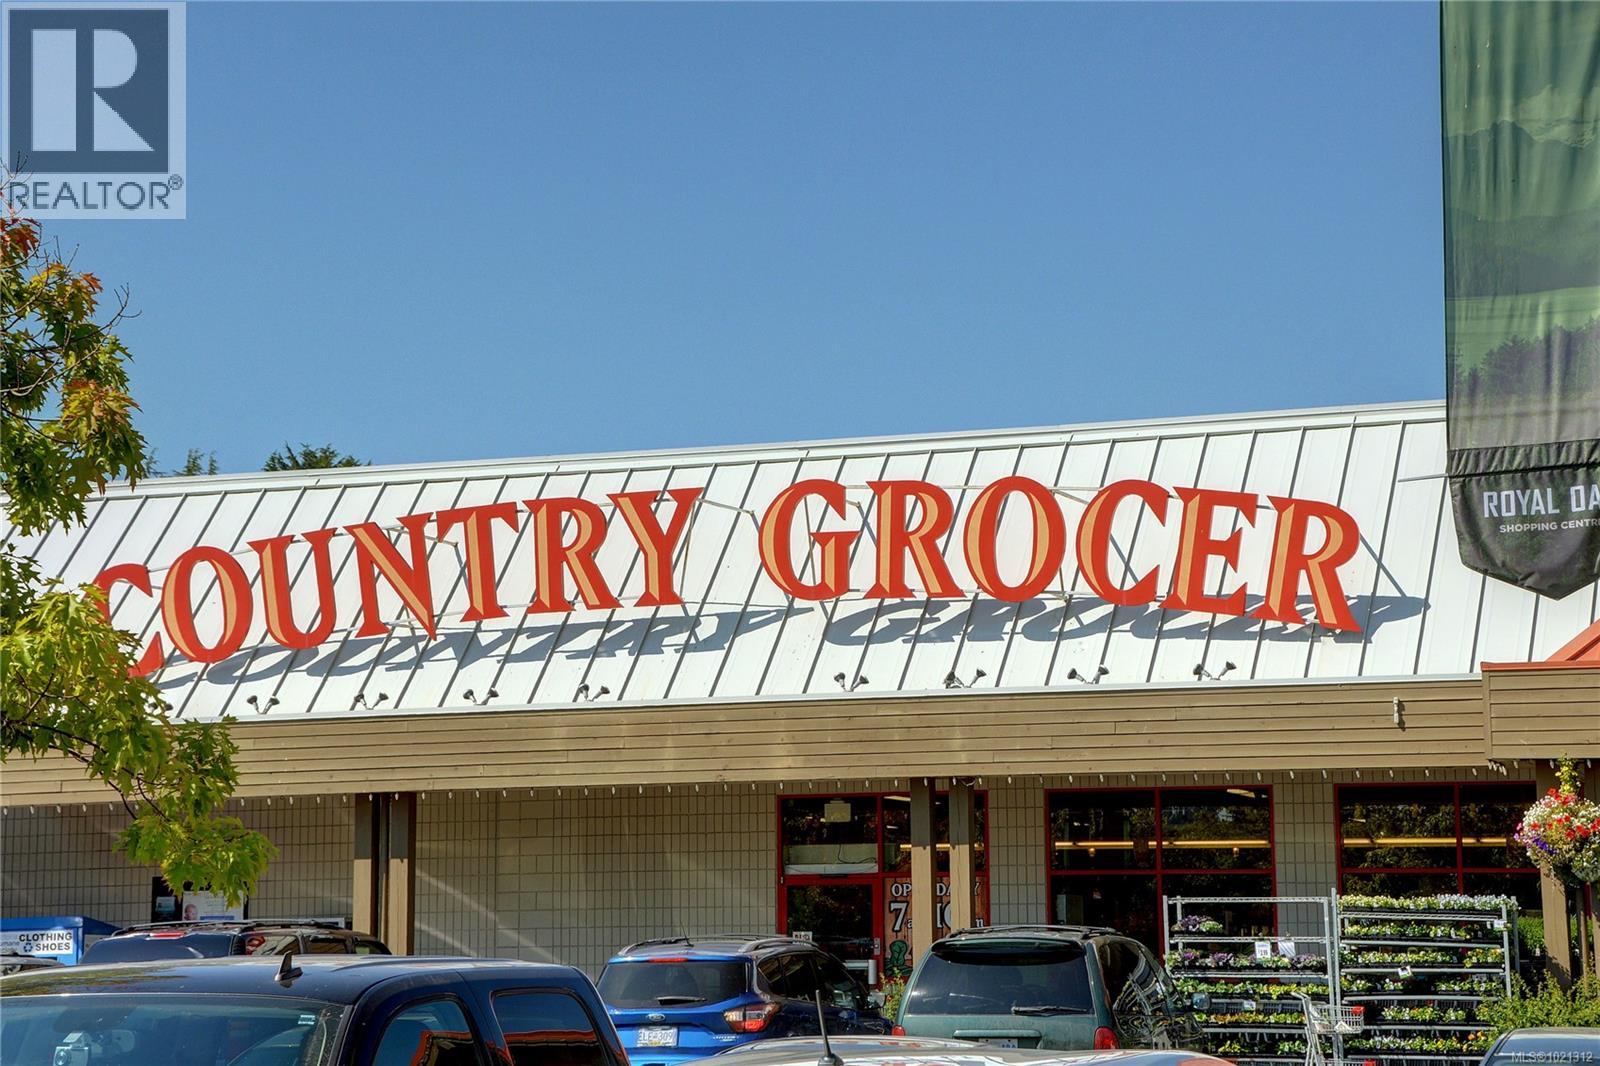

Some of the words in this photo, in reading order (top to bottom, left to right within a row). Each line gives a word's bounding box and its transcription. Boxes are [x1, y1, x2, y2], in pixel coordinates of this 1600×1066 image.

[1483, 488, 1560, 518] ROYAL
[1499, 522, 1558, 533] SHOPPING
[81, 487, 703, 677] COUNTRY
[758, 476, 1362, 633] GROCER
[891, 882, 913, 897] OP
[19, 932, 72, 942] CLOTHING
[35, 942, 71, 951] SHOES
